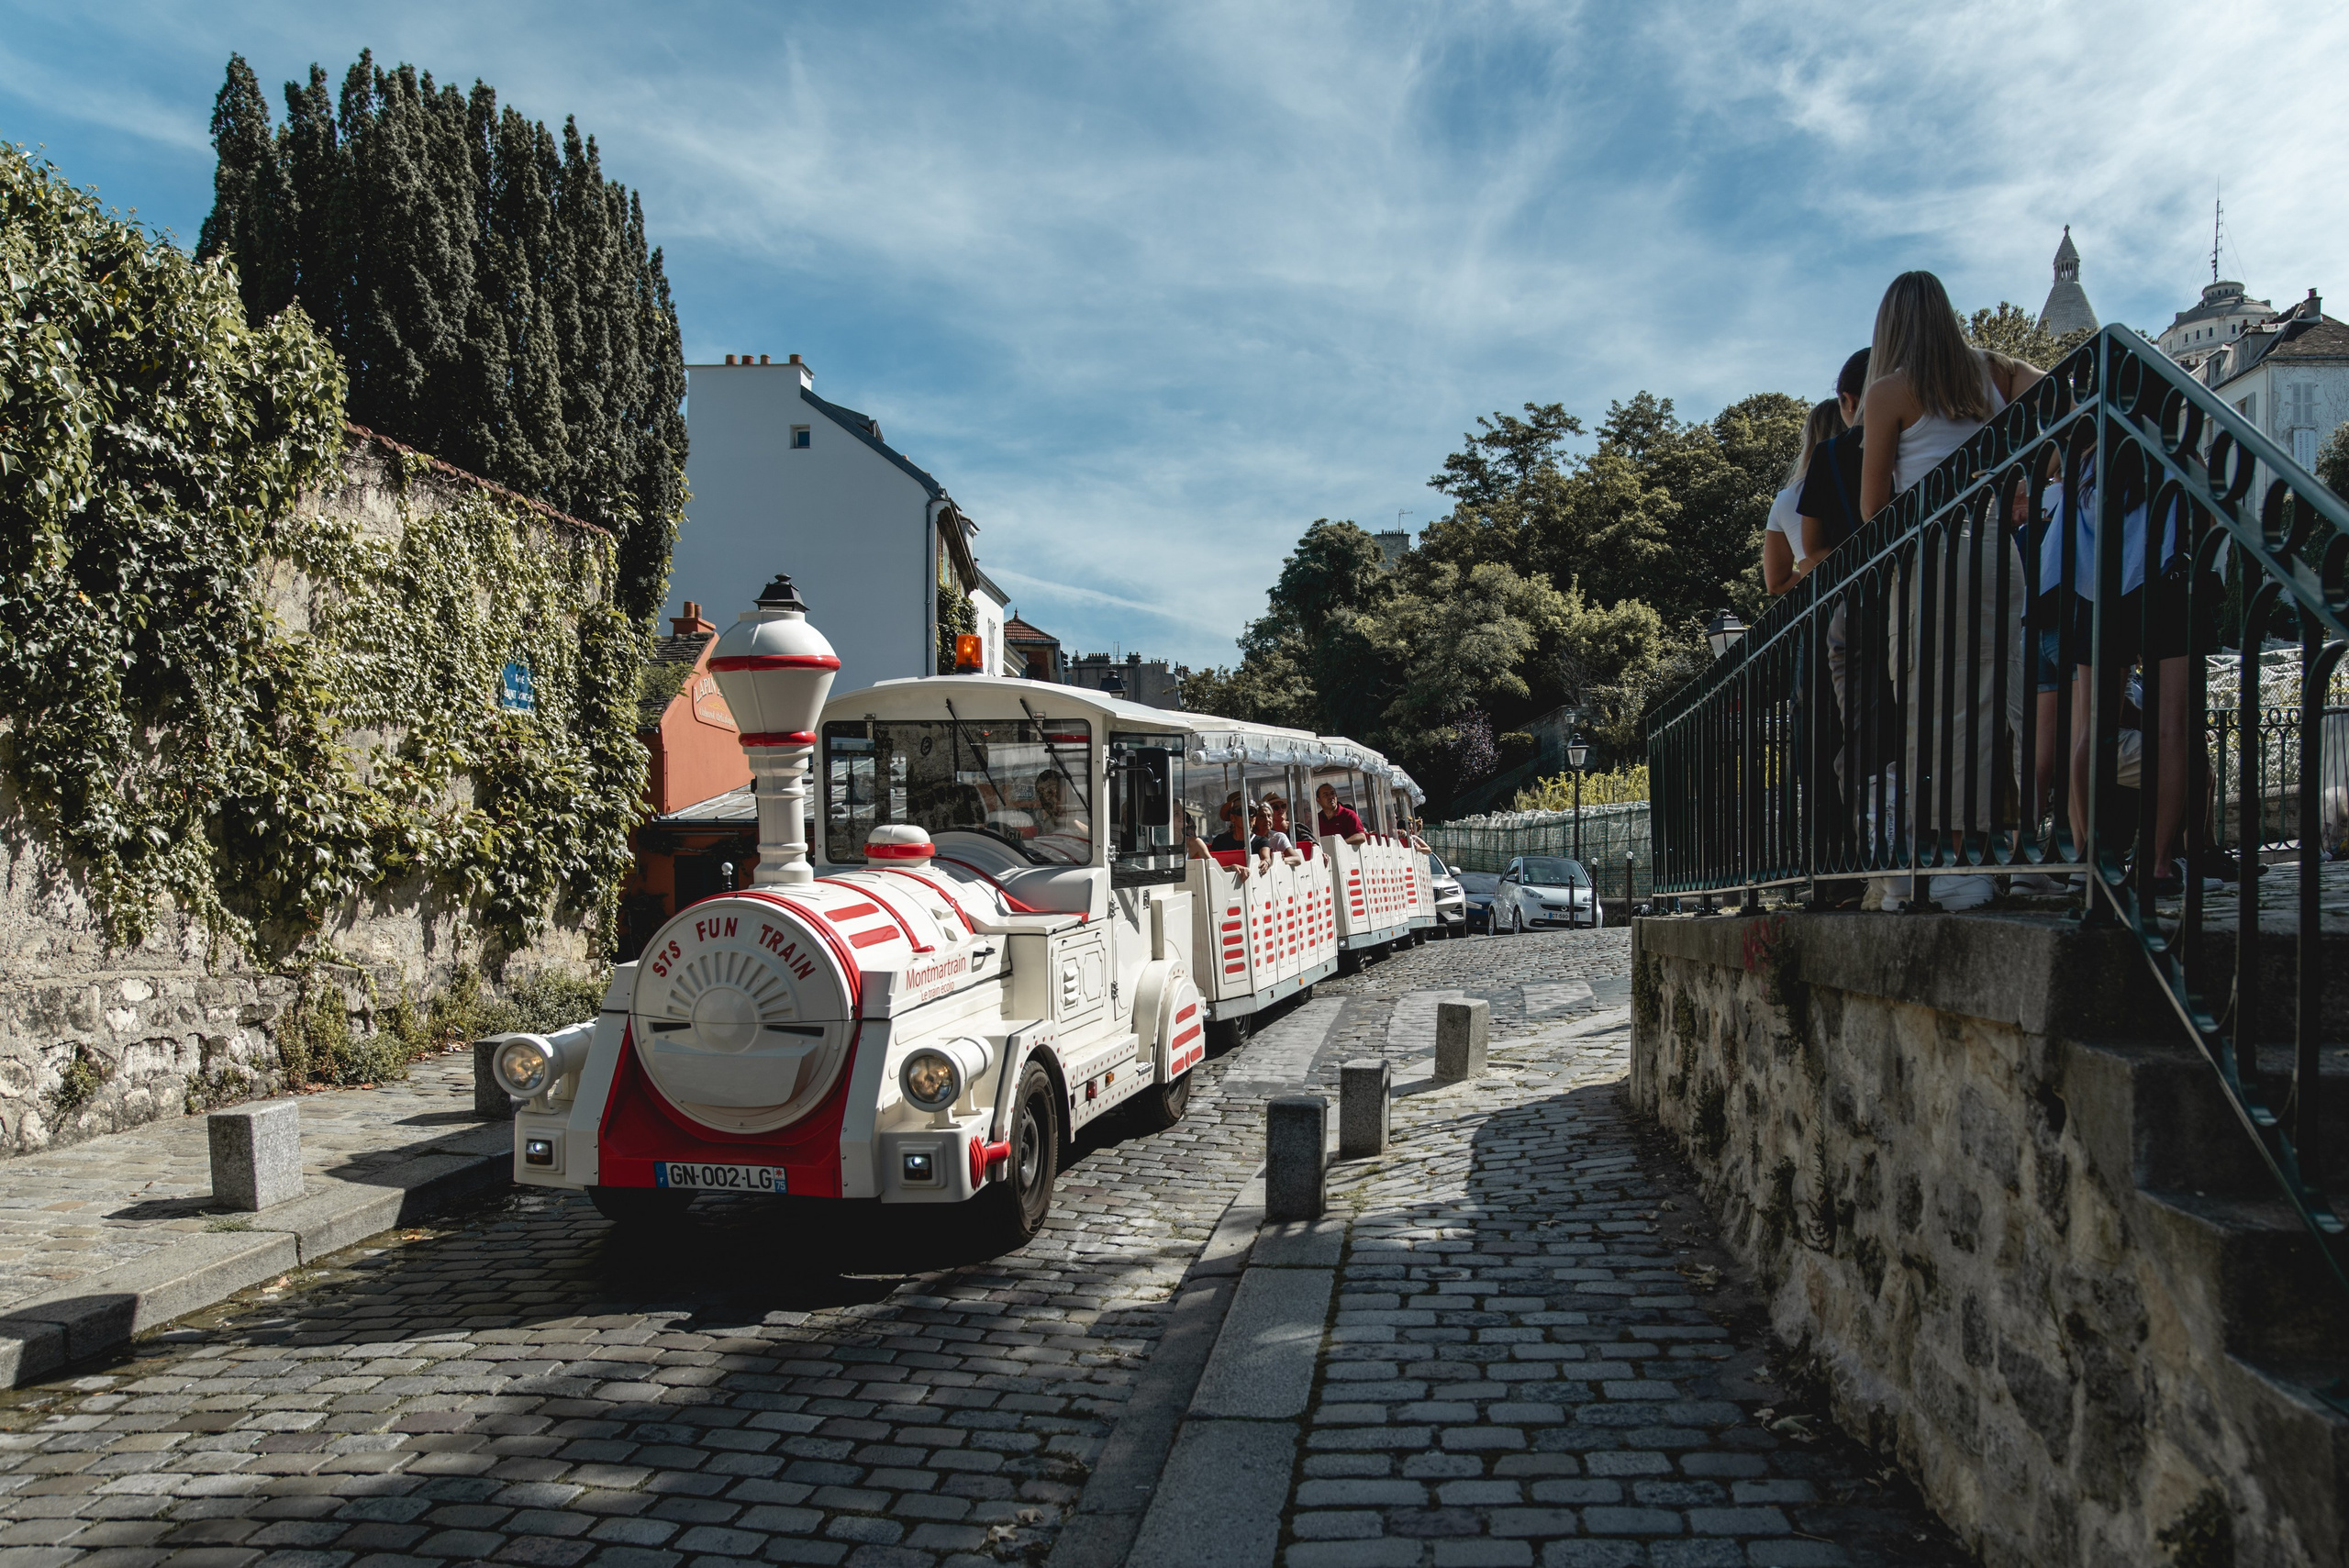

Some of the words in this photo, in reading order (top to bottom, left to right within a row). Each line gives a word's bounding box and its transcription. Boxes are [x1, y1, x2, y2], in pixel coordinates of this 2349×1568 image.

[694, 677, 717, 704] LAPIN
[652, 940, 681, 978] STS
[696, 917, 738, 942] FUN
[759, 924, 817, 981] TRAIN
[906, 953, 966, 991] Montmartrain
[920, 990, 928, 1001] Le
[929, 984, 941, 999] train
[670, 1164, 773, 1189] GN-002-LG
[775, 1181, 785, 1191] 75
